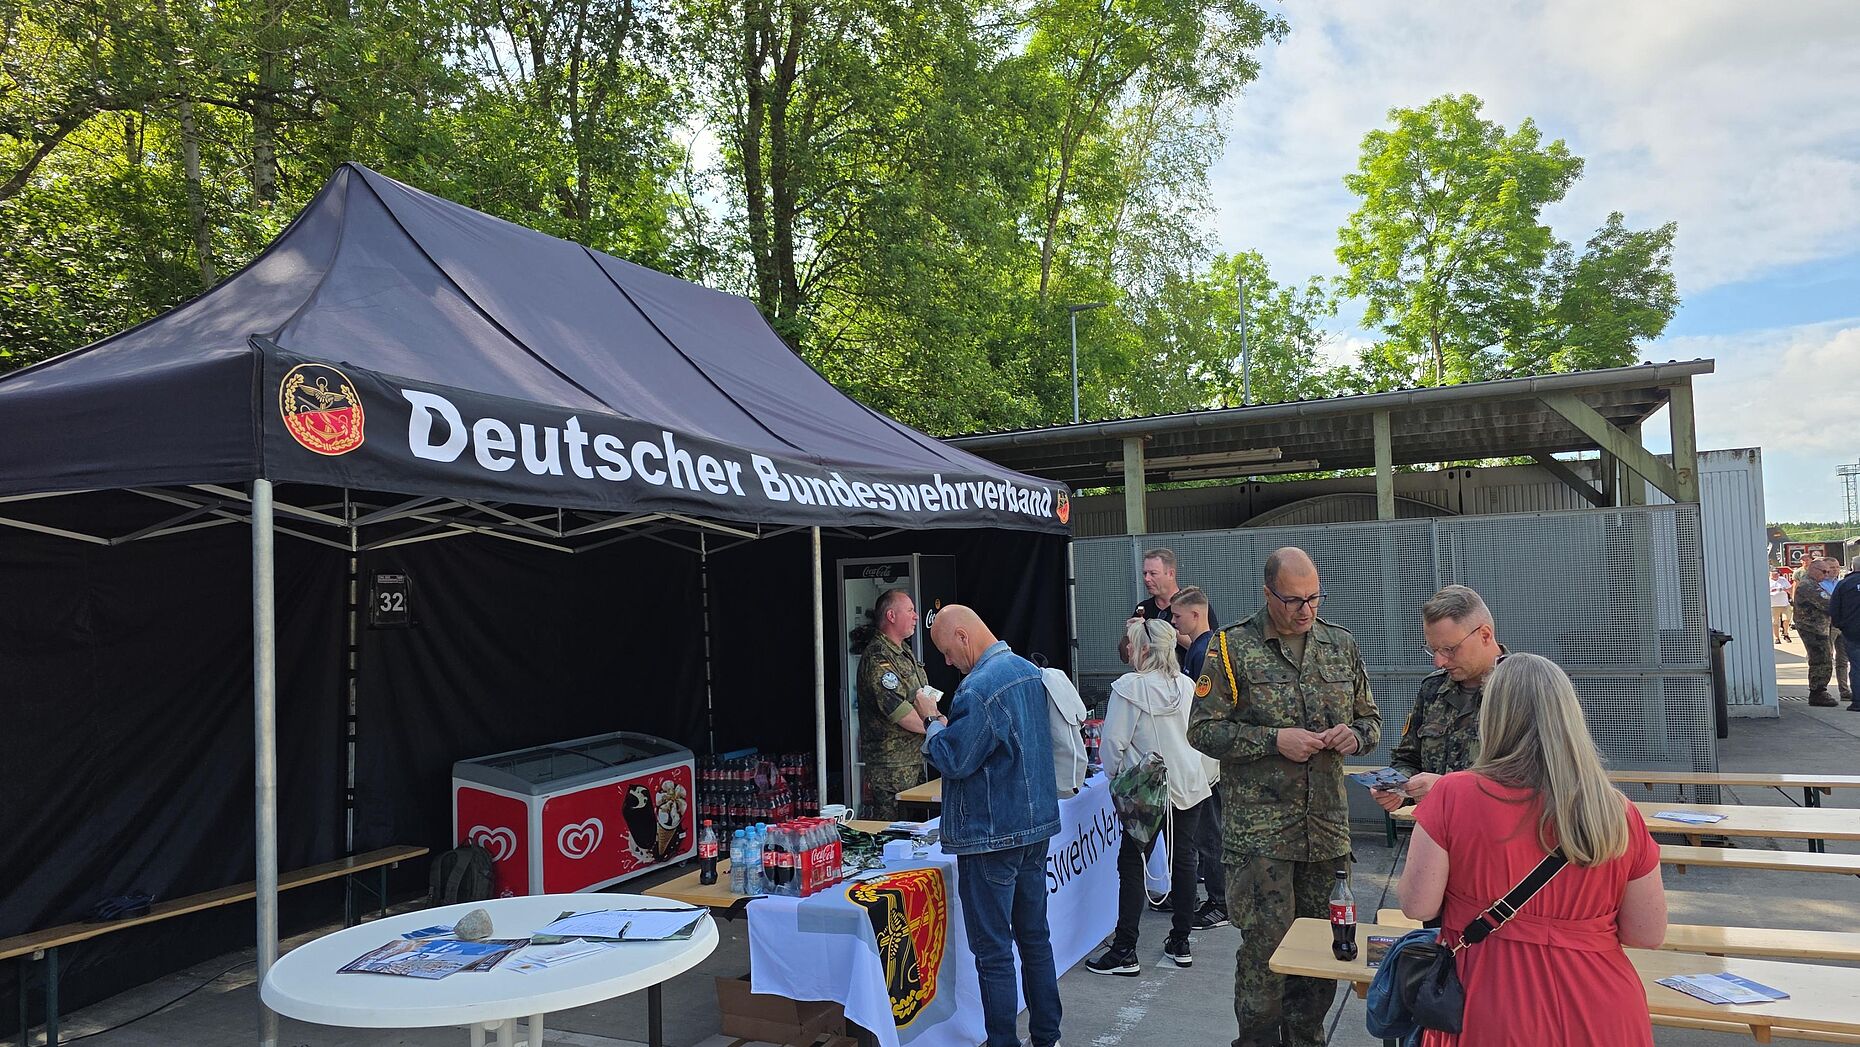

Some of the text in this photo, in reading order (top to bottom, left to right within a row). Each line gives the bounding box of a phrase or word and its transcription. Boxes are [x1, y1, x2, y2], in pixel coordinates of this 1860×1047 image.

[401, 388, 1052, 518] Deutscher Bundeswehrverband
[380, 592, 404, 612] 32
